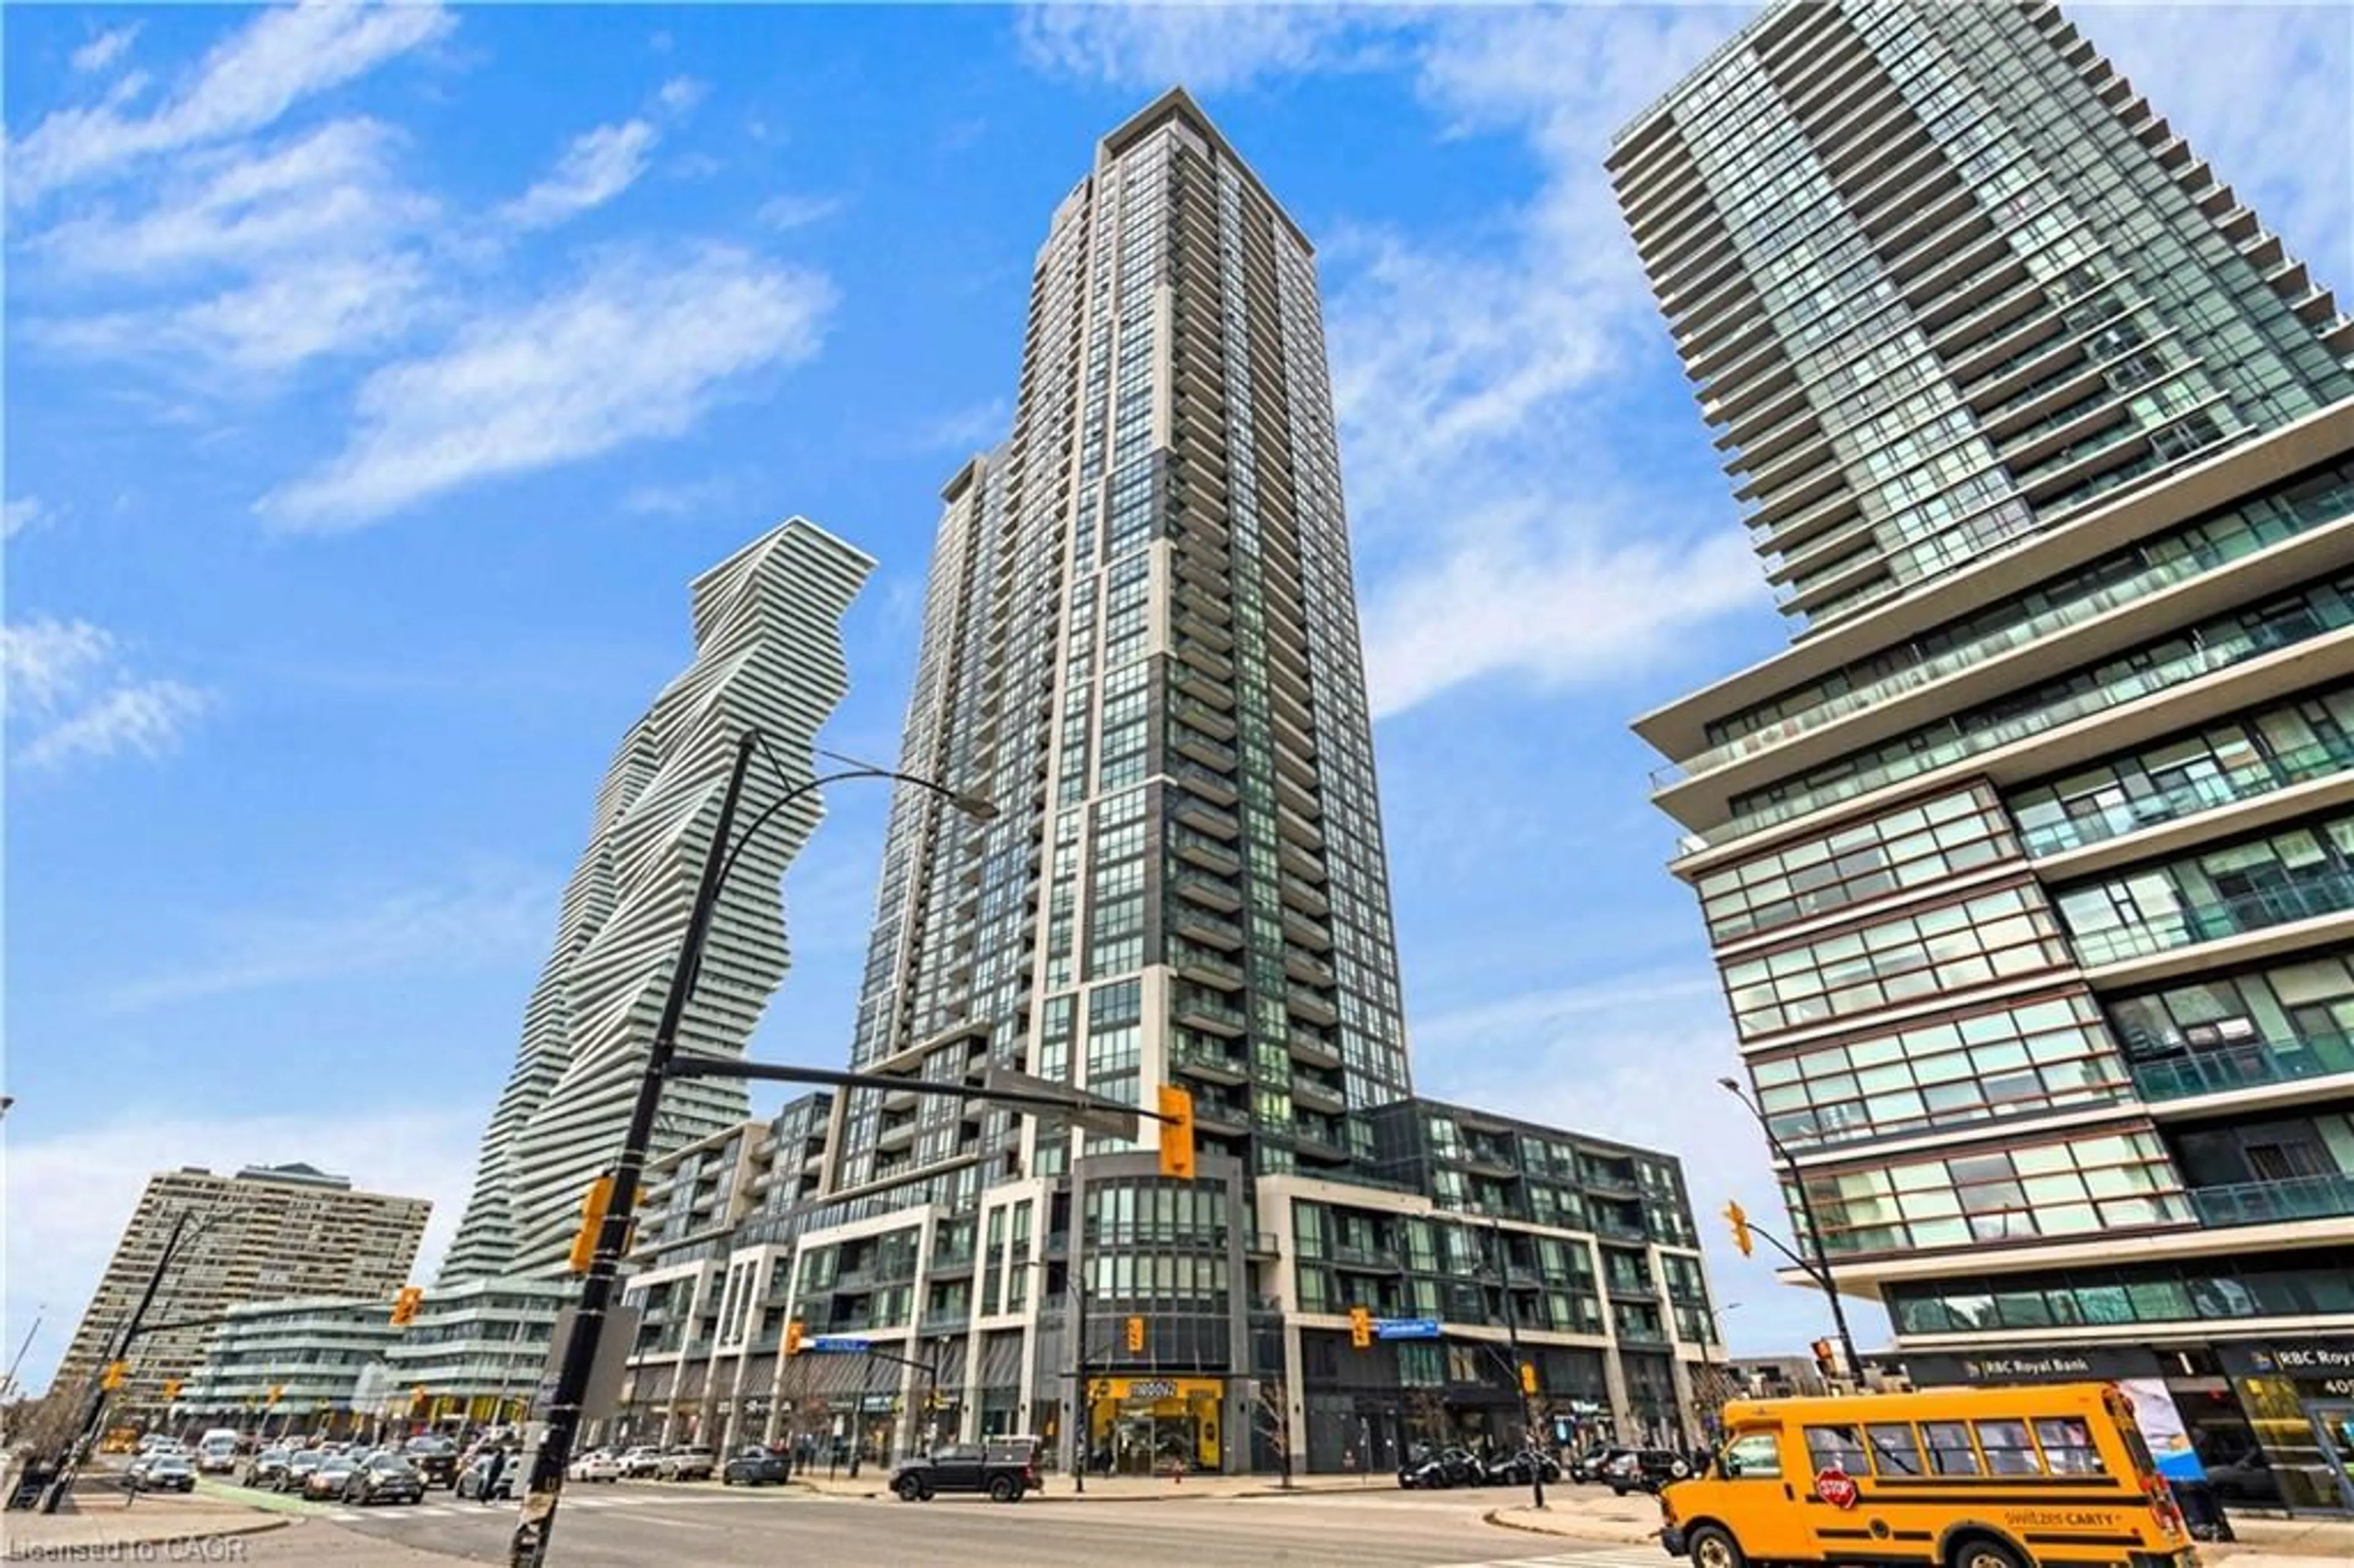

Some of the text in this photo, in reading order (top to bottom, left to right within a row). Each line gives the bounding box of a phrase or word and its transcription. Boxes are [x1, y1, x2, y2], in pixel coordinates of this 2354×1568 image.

[1986, 1358, 2089, 1375] RBC Royal Bank
[2280, 1350, 2354, 1367] RBC Roy
[1820, 1479, 1850, 1494] STOP
